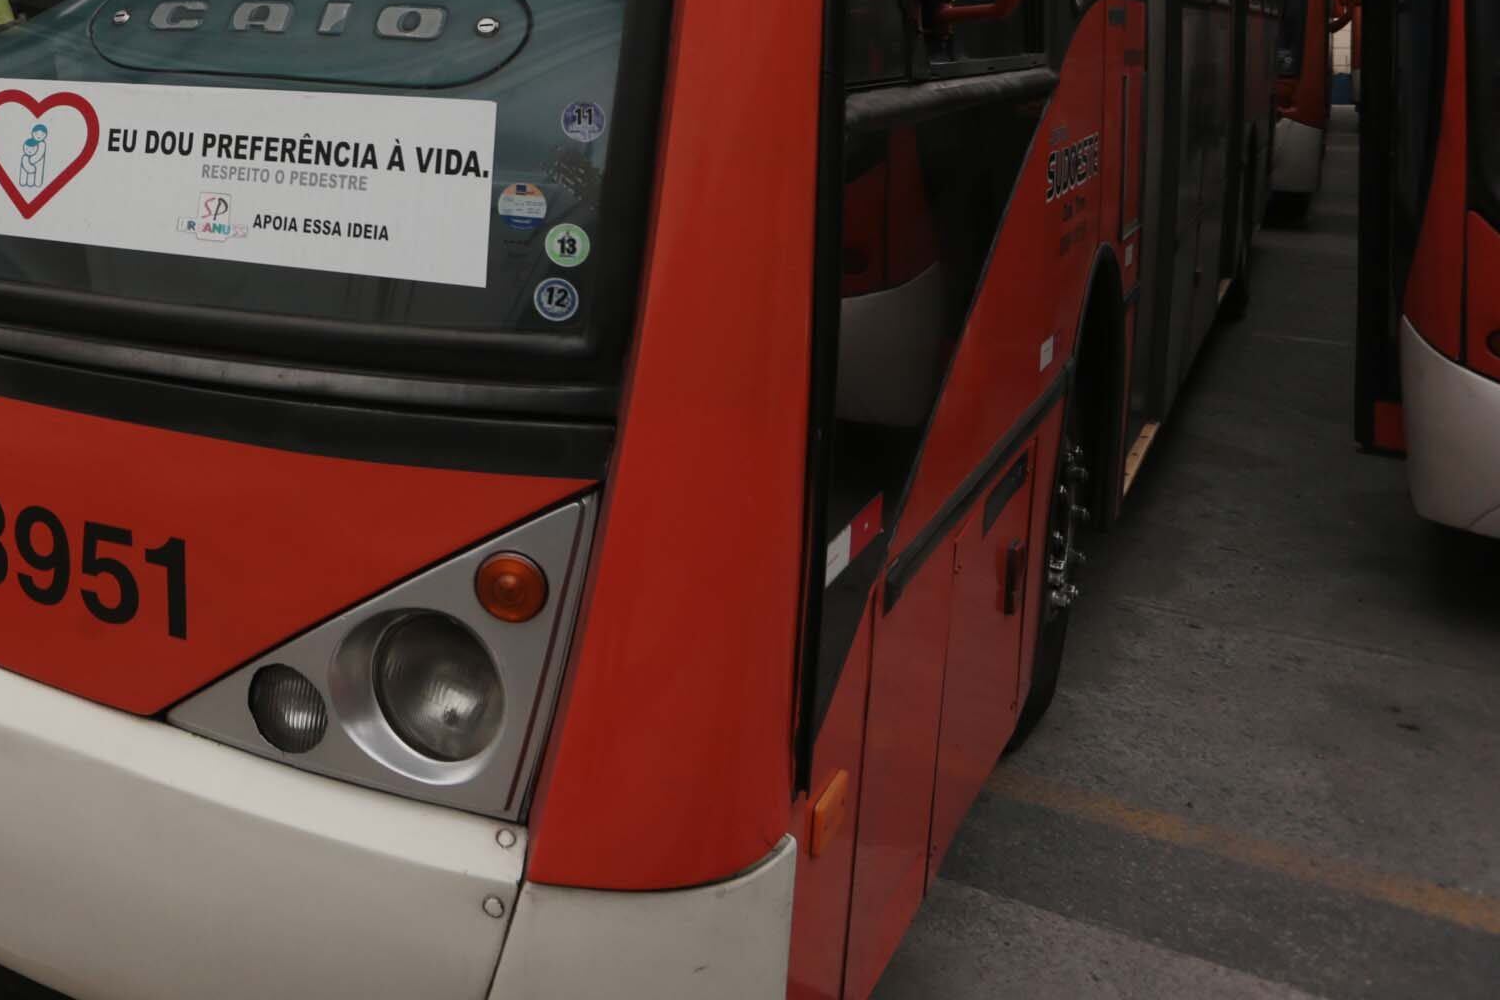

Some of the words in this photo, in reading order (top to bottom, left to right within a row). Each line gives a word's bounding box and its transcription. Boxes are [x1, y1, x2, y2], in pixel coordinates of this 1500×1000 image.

[150, 0, 449, 42] CAIO
[575, 108, 593, 125] 11
[107, 128, 137, 153] EU
[144, 130, 194, 156] DOU
[201, 133, 378, 170] PREFERÊNCIA
[386, 138, 405, 173] À
[415, 146, 490, 179] VIDA.
[201, 163, 271, 184] RESPEITO
[274, 168, 285, 185] O
[289, 171, 368, 192] PEDESTRE
[202, 197, 229, 221] SP
[252, 214, 298, 233] APOIA
[303, 218, 342, 237] ESSA
[347, 222, 389, 241] IDEIA
[557, 236, 577, 255] 13
[546, 286, 569, 308] 12
